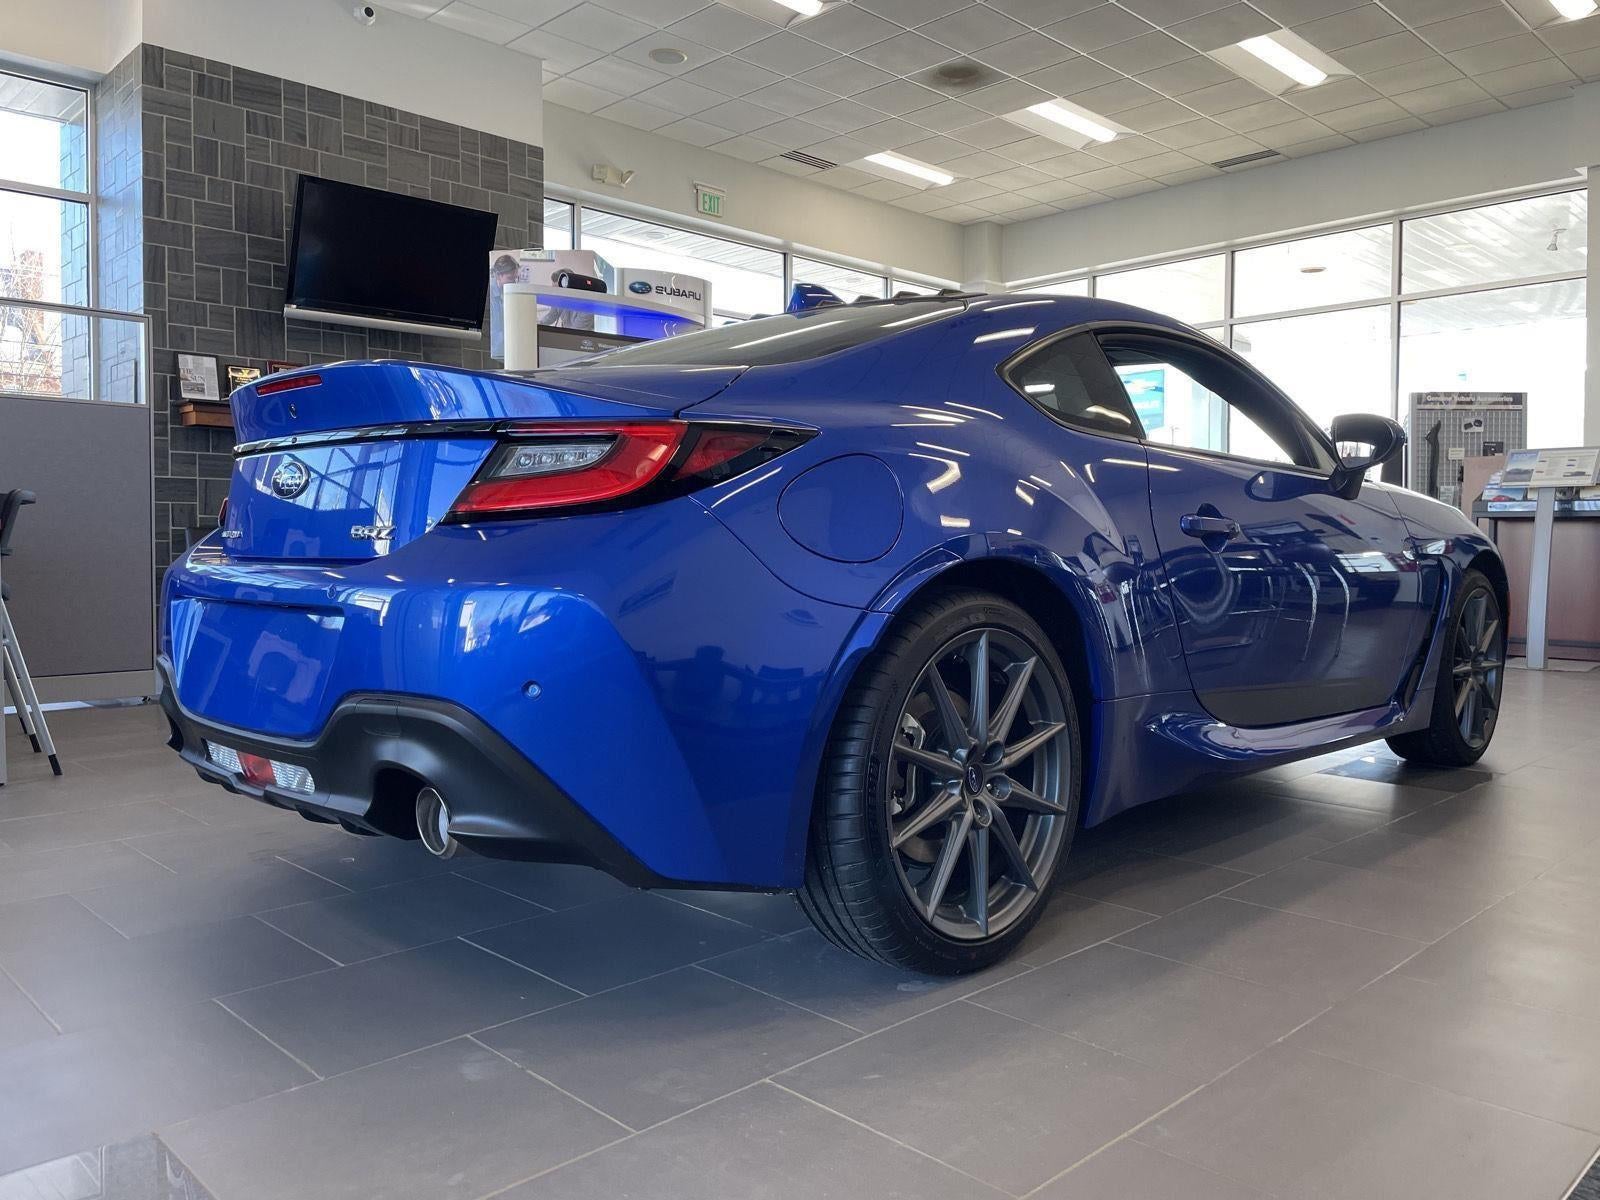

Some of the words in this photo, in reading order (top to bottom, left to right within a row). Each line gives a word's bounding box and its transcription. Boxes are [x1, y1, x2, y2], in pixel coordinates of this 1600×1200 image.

[702, 192, 720, 214] EXIT
[655, 286, 701, 301] SUBARU
[351, 525, 395, 540] BRZ
